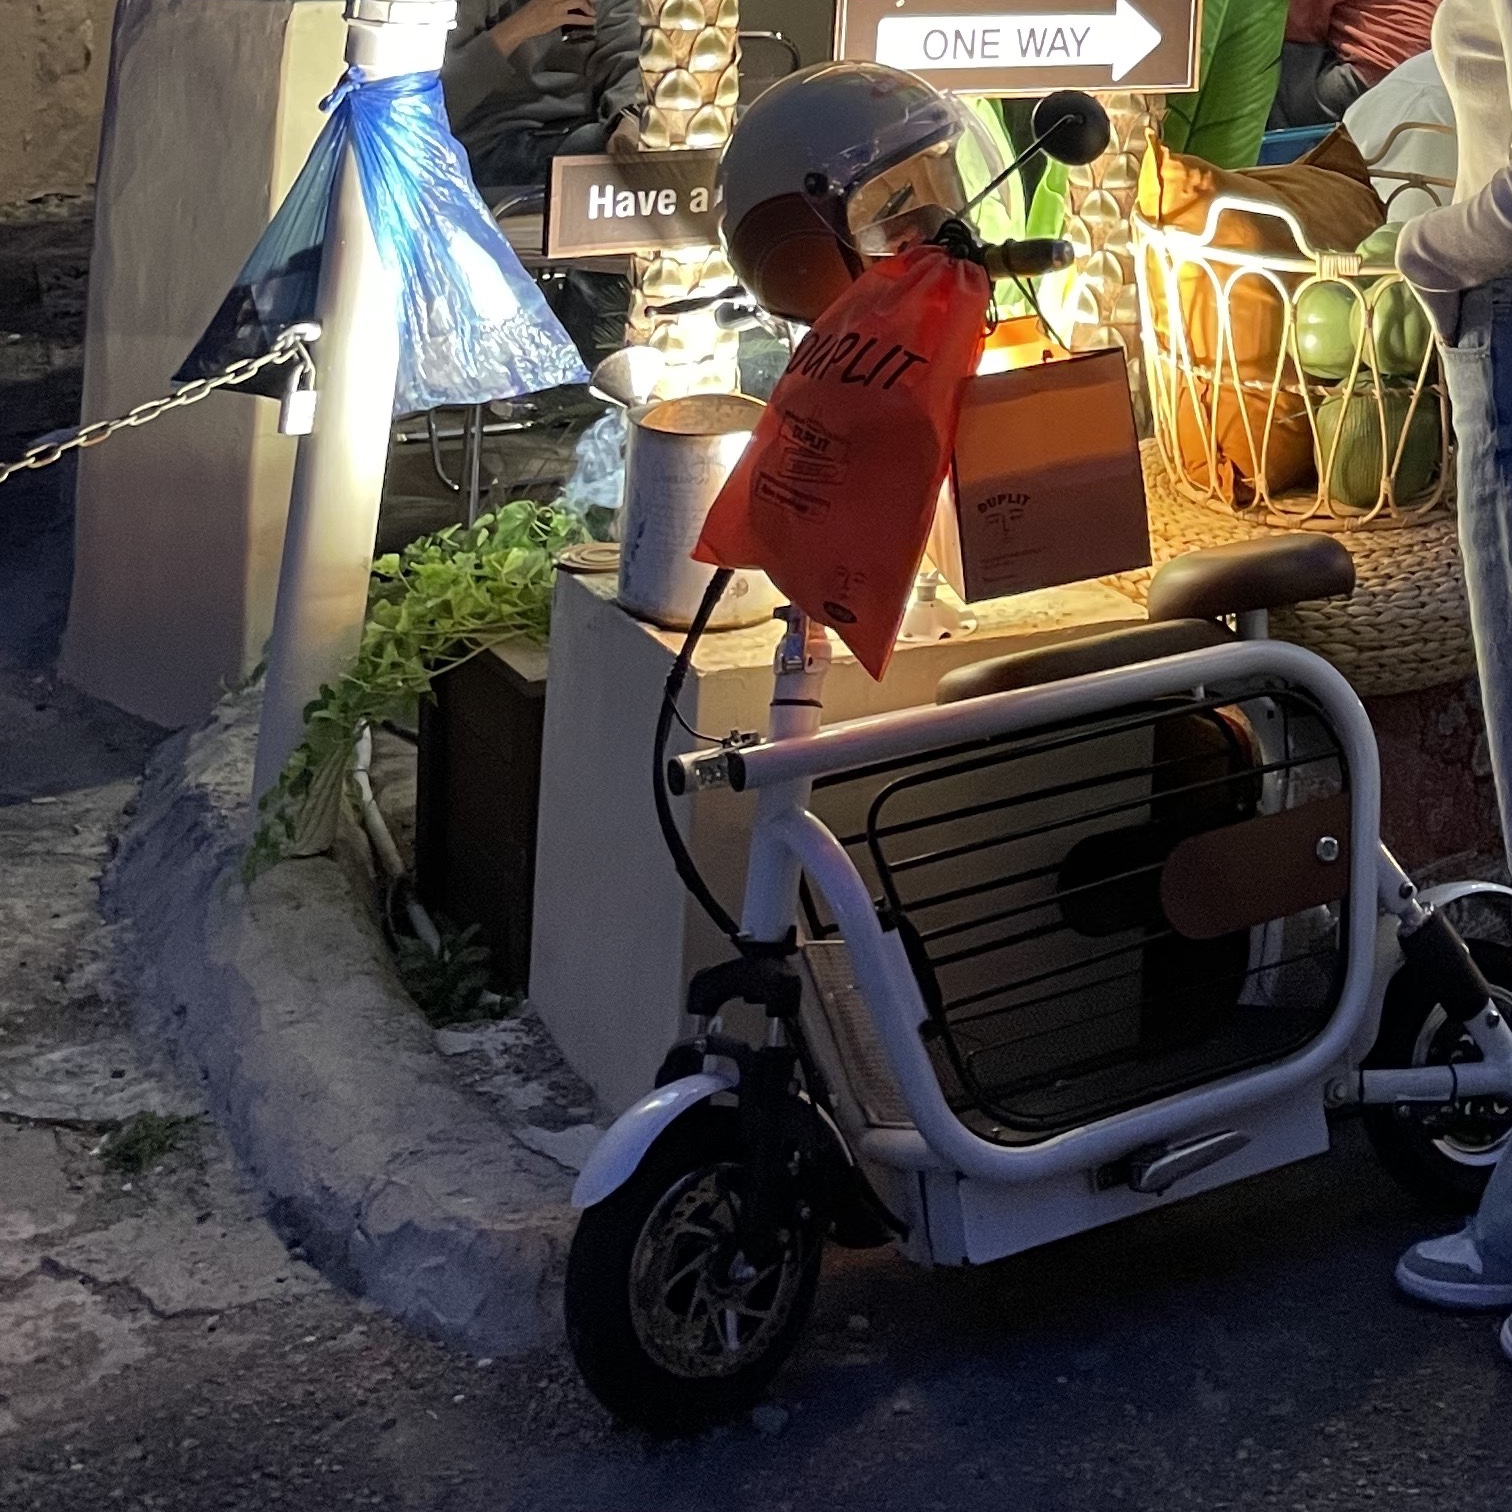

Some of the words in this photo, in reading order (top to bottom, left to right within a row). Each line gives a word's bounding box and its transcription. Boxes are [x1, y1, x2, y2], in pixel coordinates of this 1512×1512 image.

[923, 28, 1001, 61] ONE
[1017, 26, 1091, 58] WAY
[588, 184, 677, 220] Have
[689, 187, 709, 213] a
[786, 332, 930, 390] DUPLIT
[977, 493, 1031, 514] DUPLIT
